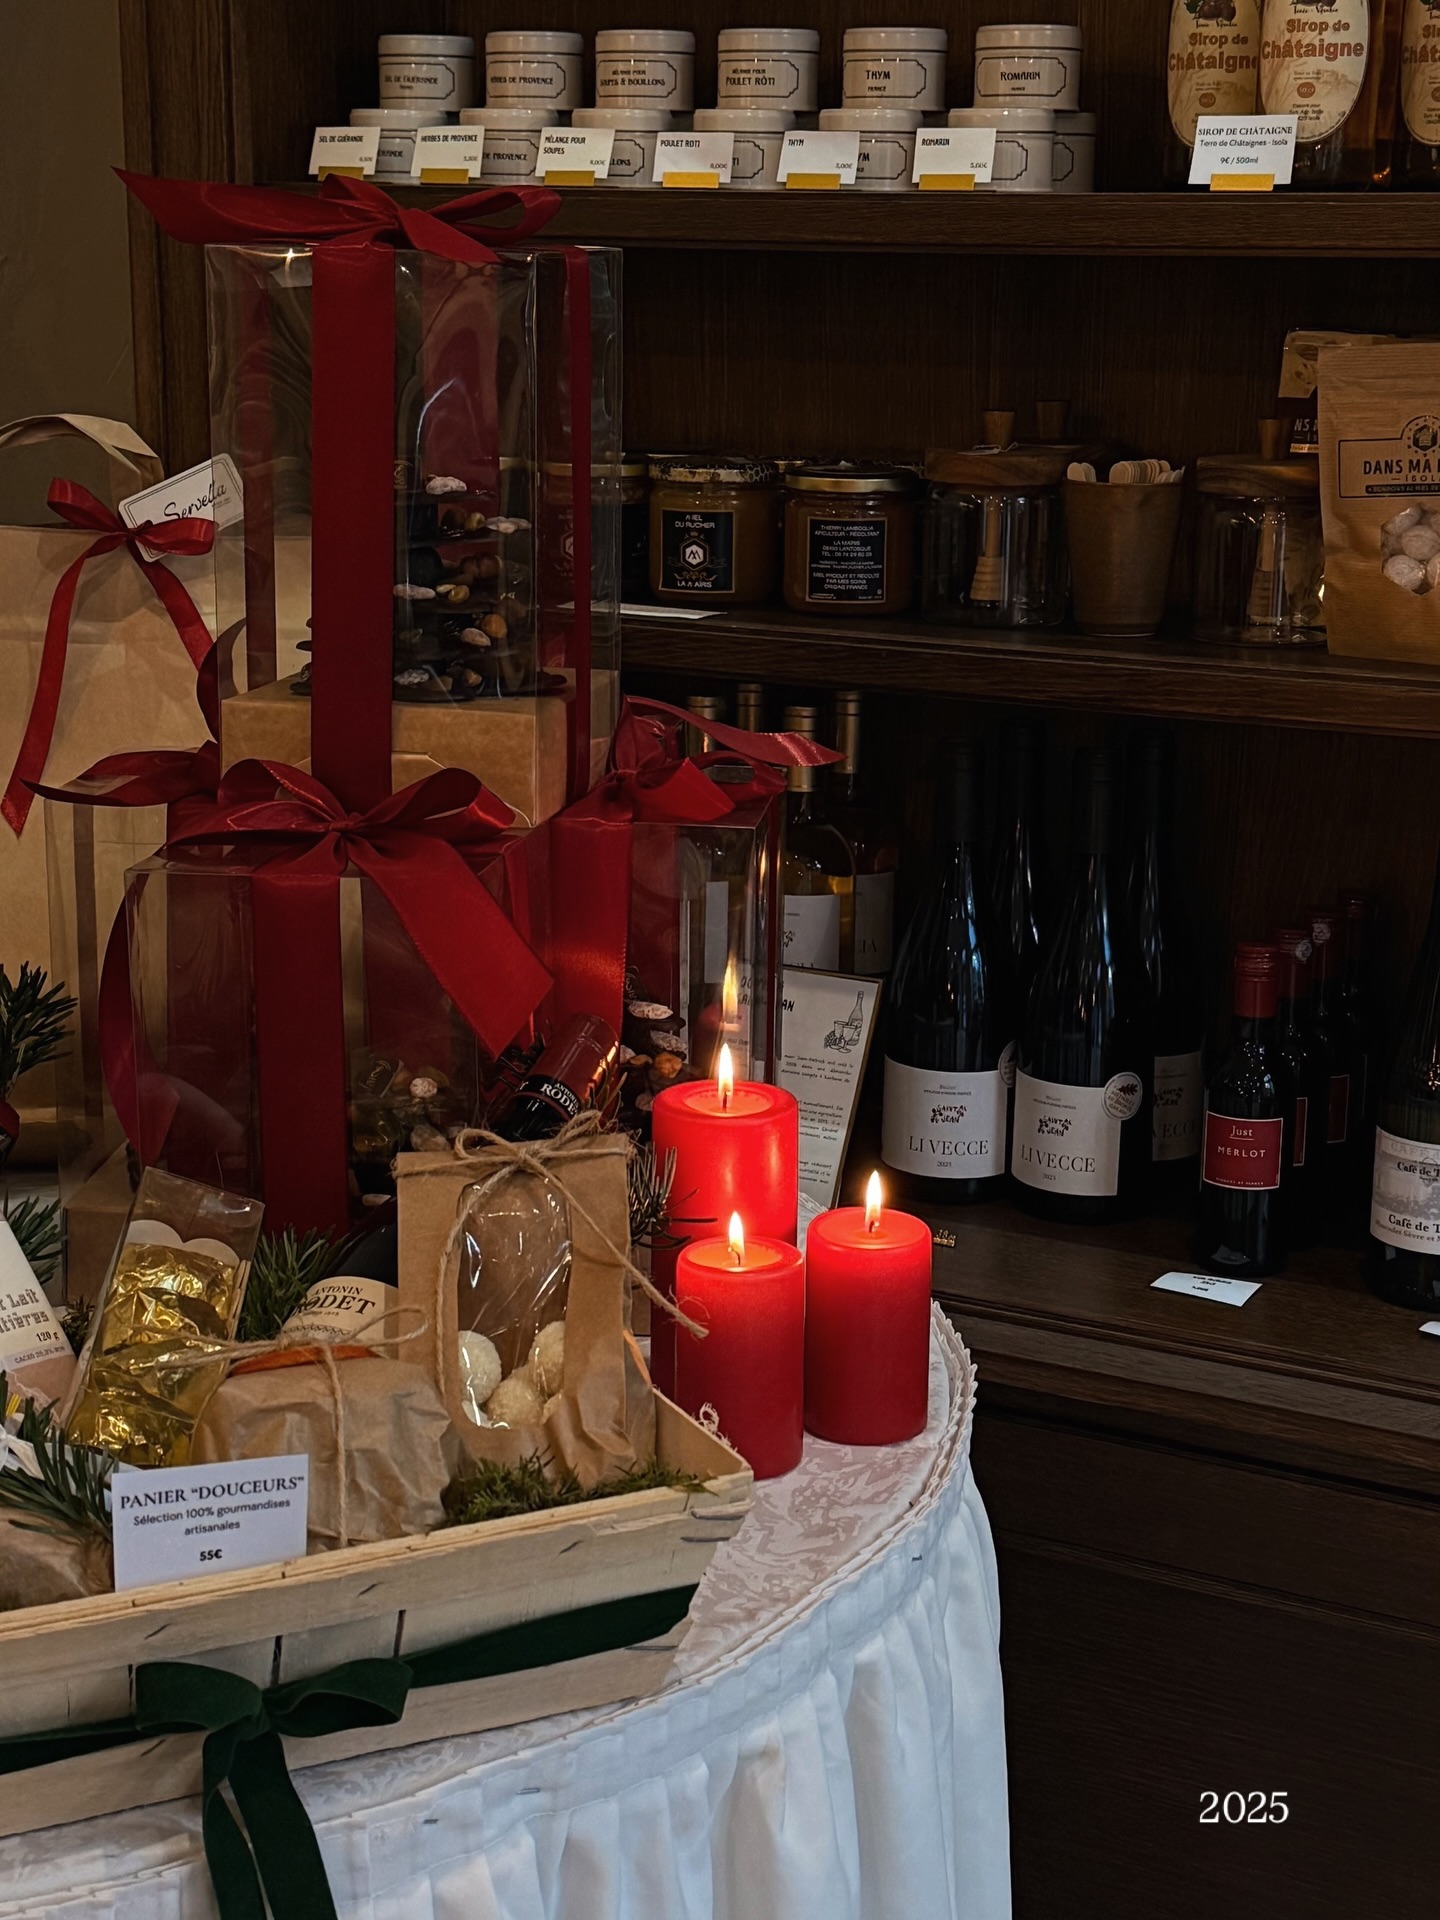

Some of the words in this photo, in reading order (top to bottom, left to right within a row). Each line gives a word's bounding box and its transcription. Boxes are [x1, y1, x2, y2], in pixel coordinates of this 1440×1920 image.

[1286, 18, 1329, 35] Sirop
[1332, 19, 1350, 33] de
[1188, 32, 1228, 48] Sirop
[1231, 33, 1249, 44] de
[1261, 38, 1365, 62] Châtaigne
[865, 70, 891, 80] THYM
[1000, 71, 1040, 81] ROMARIN
[508, 76, 517, 84] DE
[518, 76, 554, 85] PROVENCE
[627, 79, 666, 87] BOUILLONS
[725, 76, 752, 86] POULET
[754, 75, 775, 86] RÔTI
[1198, 127, 1225, 136] SIROP
[1226, 127, 1237, 136] DE
[1239, 126, 1293, 136] CHÂTAIGNE
[319, 135, 328, 143] SEL
[328, 135, 337, 143] DE
[421, 135, 441, 143] HERBES
[450, 134, 478, 142] PROVENCE
[544, 134, 569, 144] MÉLANGE
[570, 136, 586, 144] POUR
[660, 139, 683, 148] POULET
[788, 138, 804, 147] THYM
[921, 138, 950, 146] ROMARIN
[1200, 139, 1218, 147] Terre
[1219, 139, 1228, 147] de
[1229, 139, 1267, 148] Châtaignes
[1272, 138, 1288, 146] Isola
[543, 147, 565, 155] SOUPES
[492, 153, 527, 161] PROVENCE
[1236, 156, 1259, 164] 500ml
[1363, 460, 1403, 475] DANS
[1408, 459, 1432, 474] MA
[686, 521, 716, 529] RUCHER
[1231, 1125, 1253, 1137] Just
[1217, 1145, 1266, 1158] MERLOT
[1397, 1161, 1417, 1174] Café
[1419, 1166, 1432, 1177] de
[1388, 1213, 1413, 1230] Café
[1415, 1221, 1430, 1234] de
[312, 1285, 364, 1296] ANTONIN
[6, 1288, 40, 1309] Lait
[36, 1331, 52, 1342] 120
[120, 1488, 188, 1510] PANIER
[133, 1511, 184, 1527] Sélection
[186, 1506, 215, 1520] 100%
[216, 1499, 291, 1517] gourmandises
[184, 1520, 241, 1536] artisanales
[199, 1548, 223, 1562] 55€
